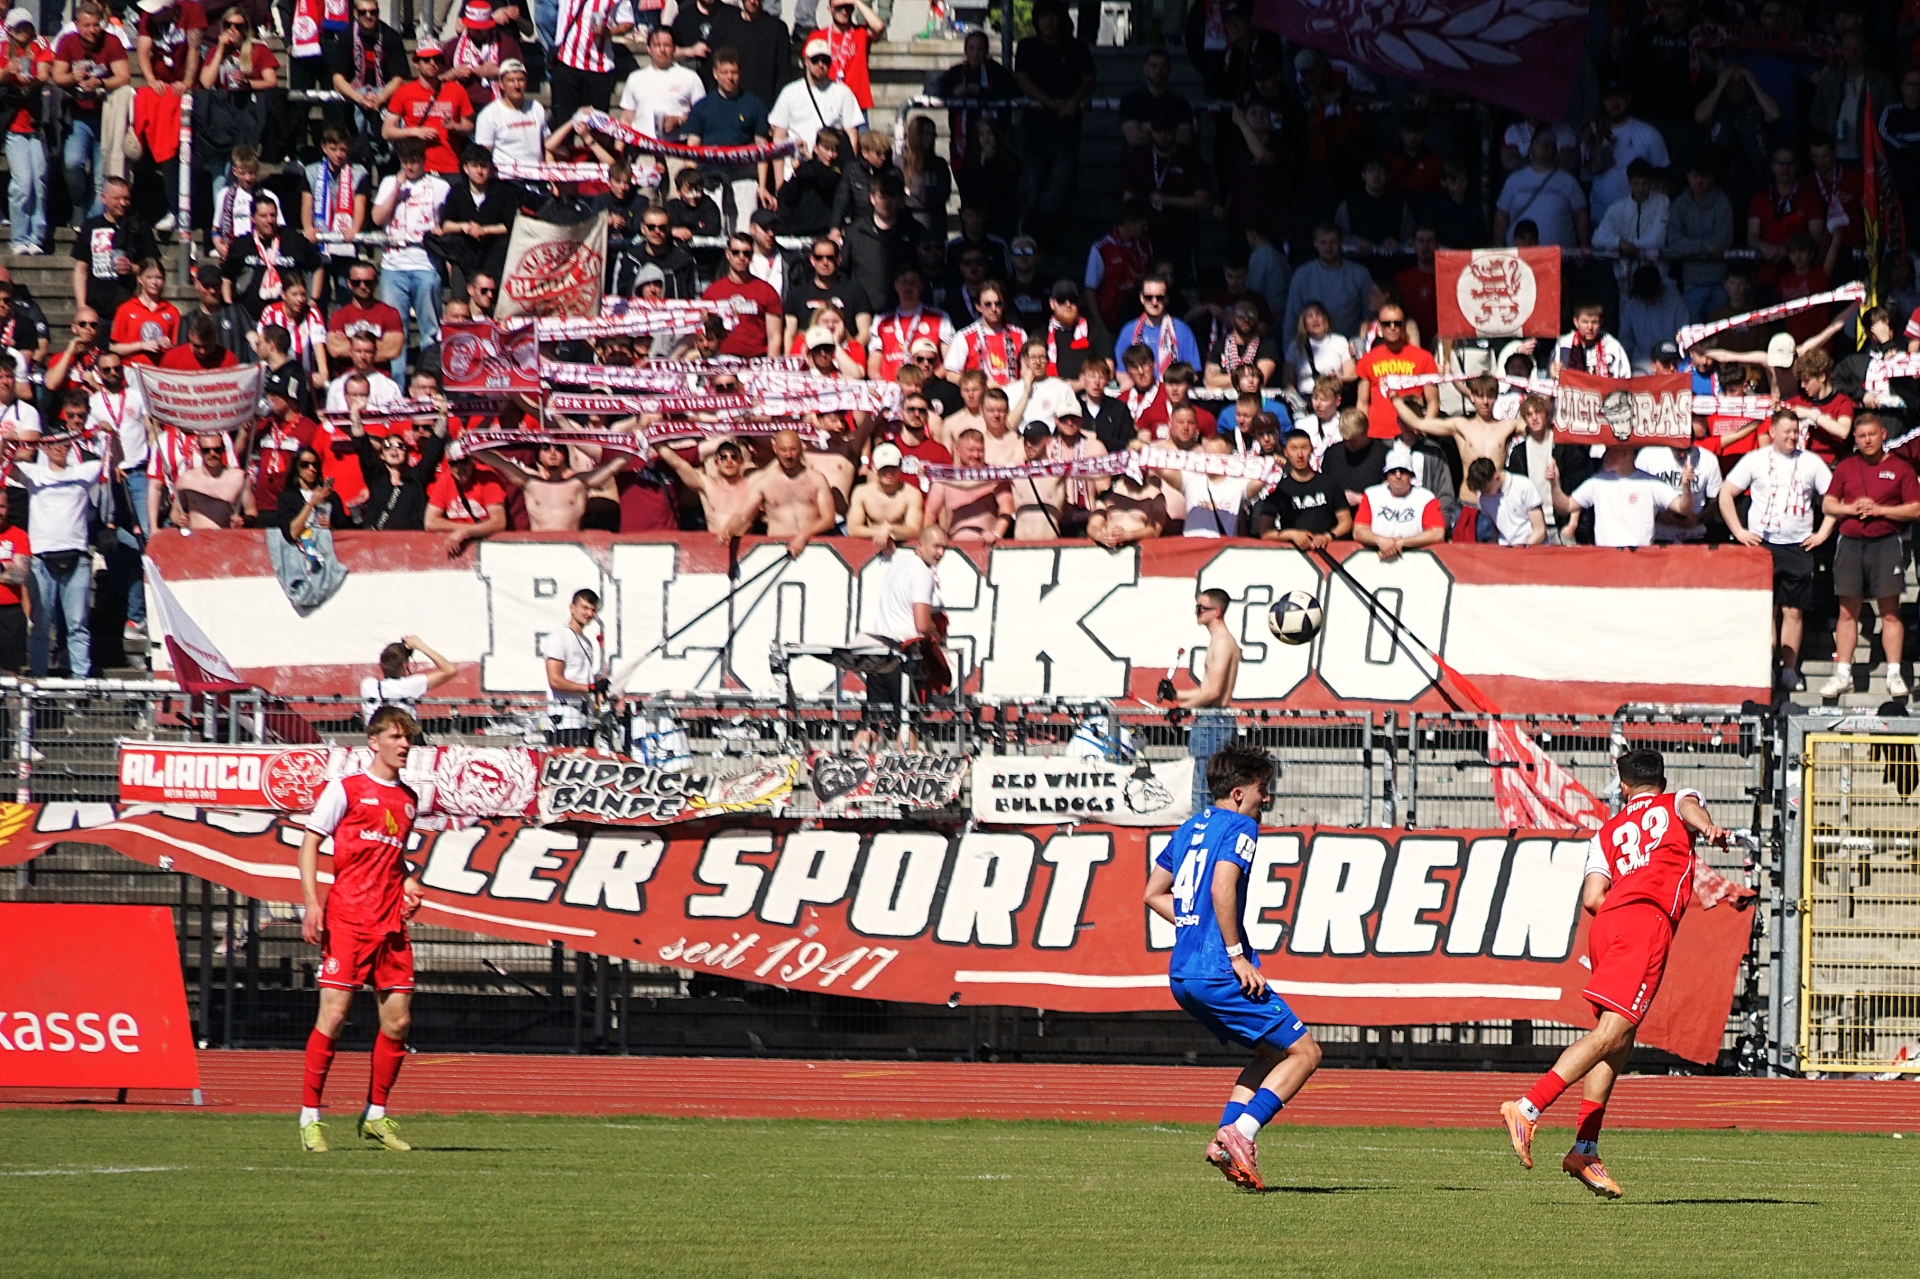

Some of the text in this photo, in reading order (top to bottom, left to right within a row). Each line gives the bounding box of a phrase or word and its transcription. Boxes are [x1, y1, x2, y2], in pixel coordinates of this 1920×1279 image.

[1376, 359, 1416, 377] KRONK
[555, 394, 620, 411] SEKTION
[478, 541, 1142, 699] BLOCK
[121, 753, 262, 791] ALIANCO
[874, 752, 964, 778] JUGEND
[873, 776, 953, 802] BANDE
[992, 772, 1118, 789] RED WHITE
[550, 787, 686, 819] BANDE
[995, 796, 1115, 815] BULLDOGS
[688, 830, 1111, 948] SPORT
[1170, 848, 1209, 914] 41
[659, 931, 899, 992] seit 1947
